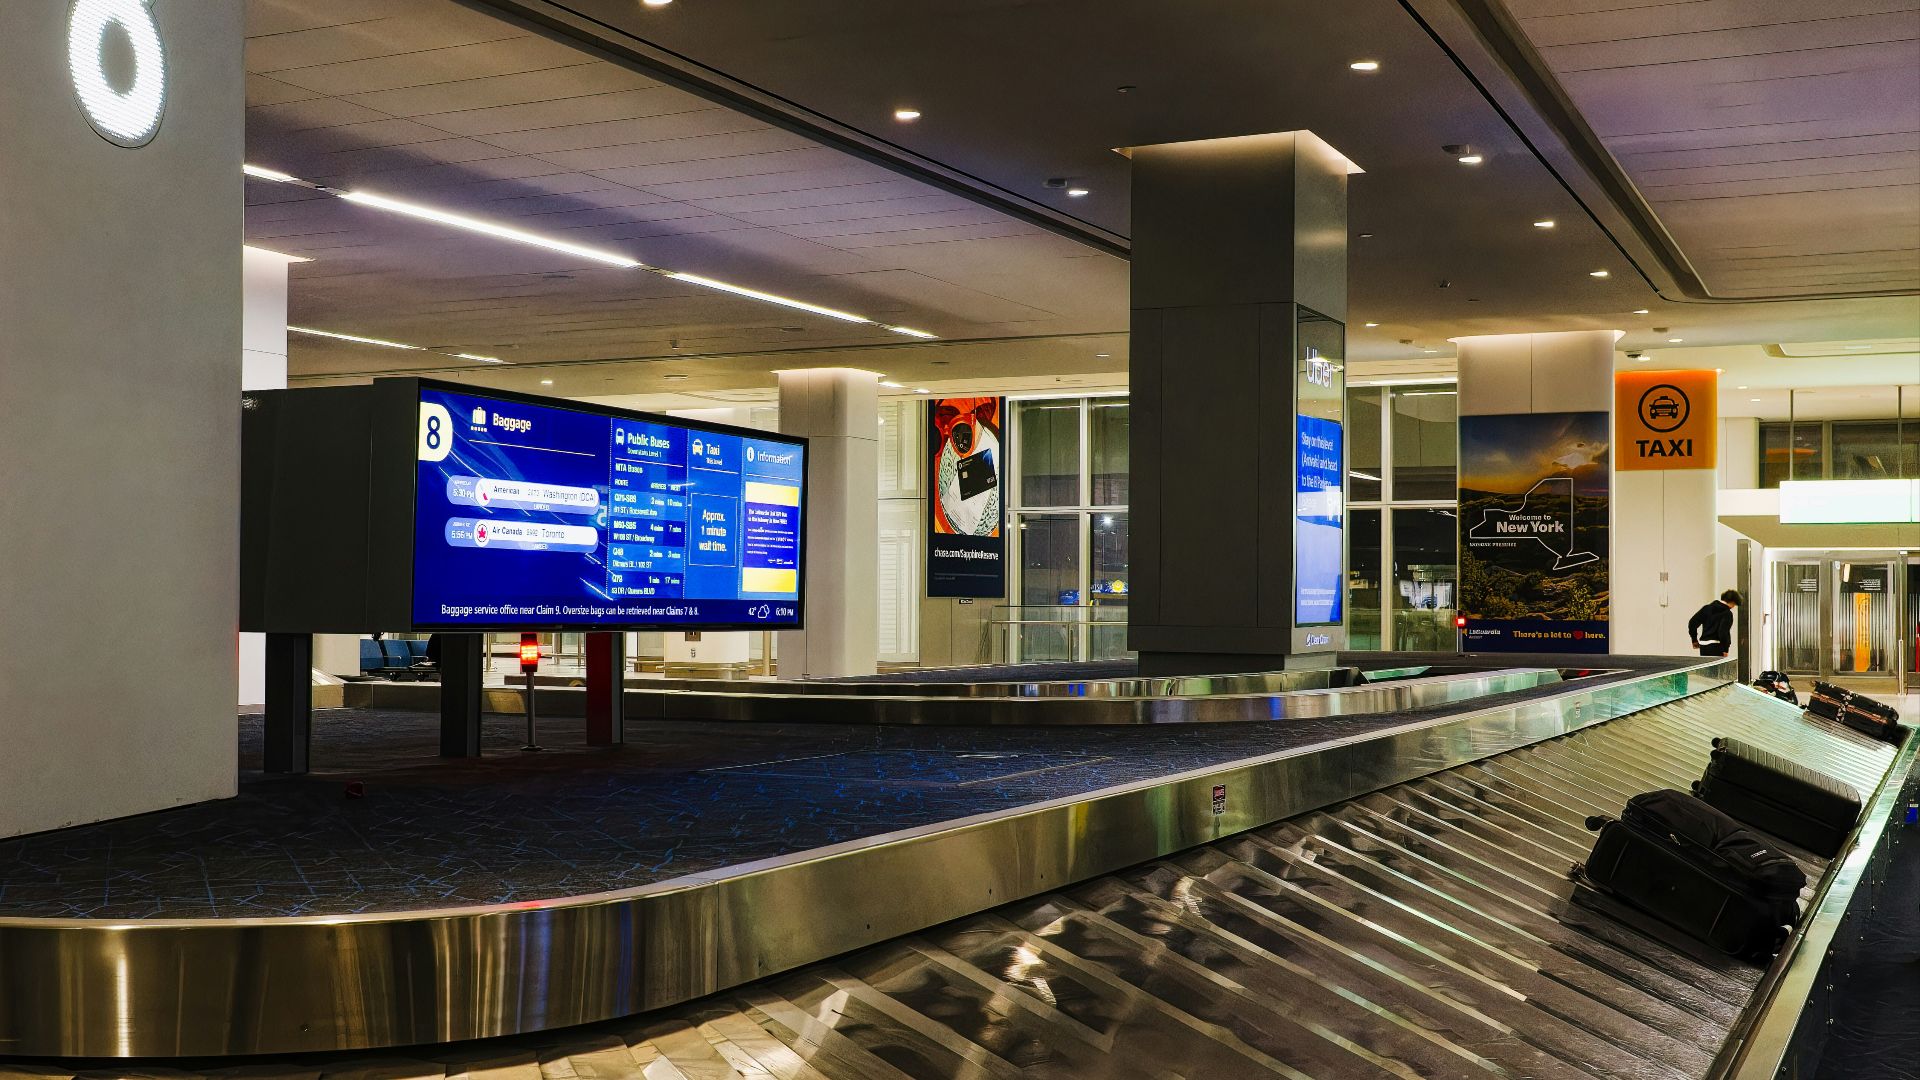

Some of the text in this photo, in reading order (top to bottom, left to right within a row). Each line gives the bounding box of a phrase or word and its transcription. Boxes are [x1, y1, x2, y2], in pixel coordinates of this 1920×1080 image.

[492, 412, 532, 433] Baggage
[426, 415, 441, 450] 8
[627, 432, 670, 449] Public Buses
[1301, 432, 1311, 449] Stay
[1635, 438, 1693, 457] TAXI
[706, 443, 720, 456] Taxi
[757, 450, 791, 466] Information
[1327, 457, 1338, 471] head
[1301, 474, 1307, 487] to
[493, 485, 521, 496] American
[543, 489, 579, 503] Washington
[702, 509, 726, 523] Approx.
[492, 526, 501, 535] Air
[501, 526, 524, 537] Canada
[541, 527, 566, 540] Toronto
[706, 527, 727, 537] minute
[1496, 520, 1565, 533] New York
[699, 540, 727, 552] wait time.
[934, 546, 999, 561] chase.com/SapphireReserve
[441, 604, 700, 618] Baggage service office near Claim 9. Oversize bags can be retrieved near Claims 7 & 8.
[748, 606, 757, 616] 42°
[775, 608, 787, 617] 6:10
[1512, 630, 1543, 638] There's
[1550, 631, 1562, 639] lot
[1584, 631, 1606, 639] here.
